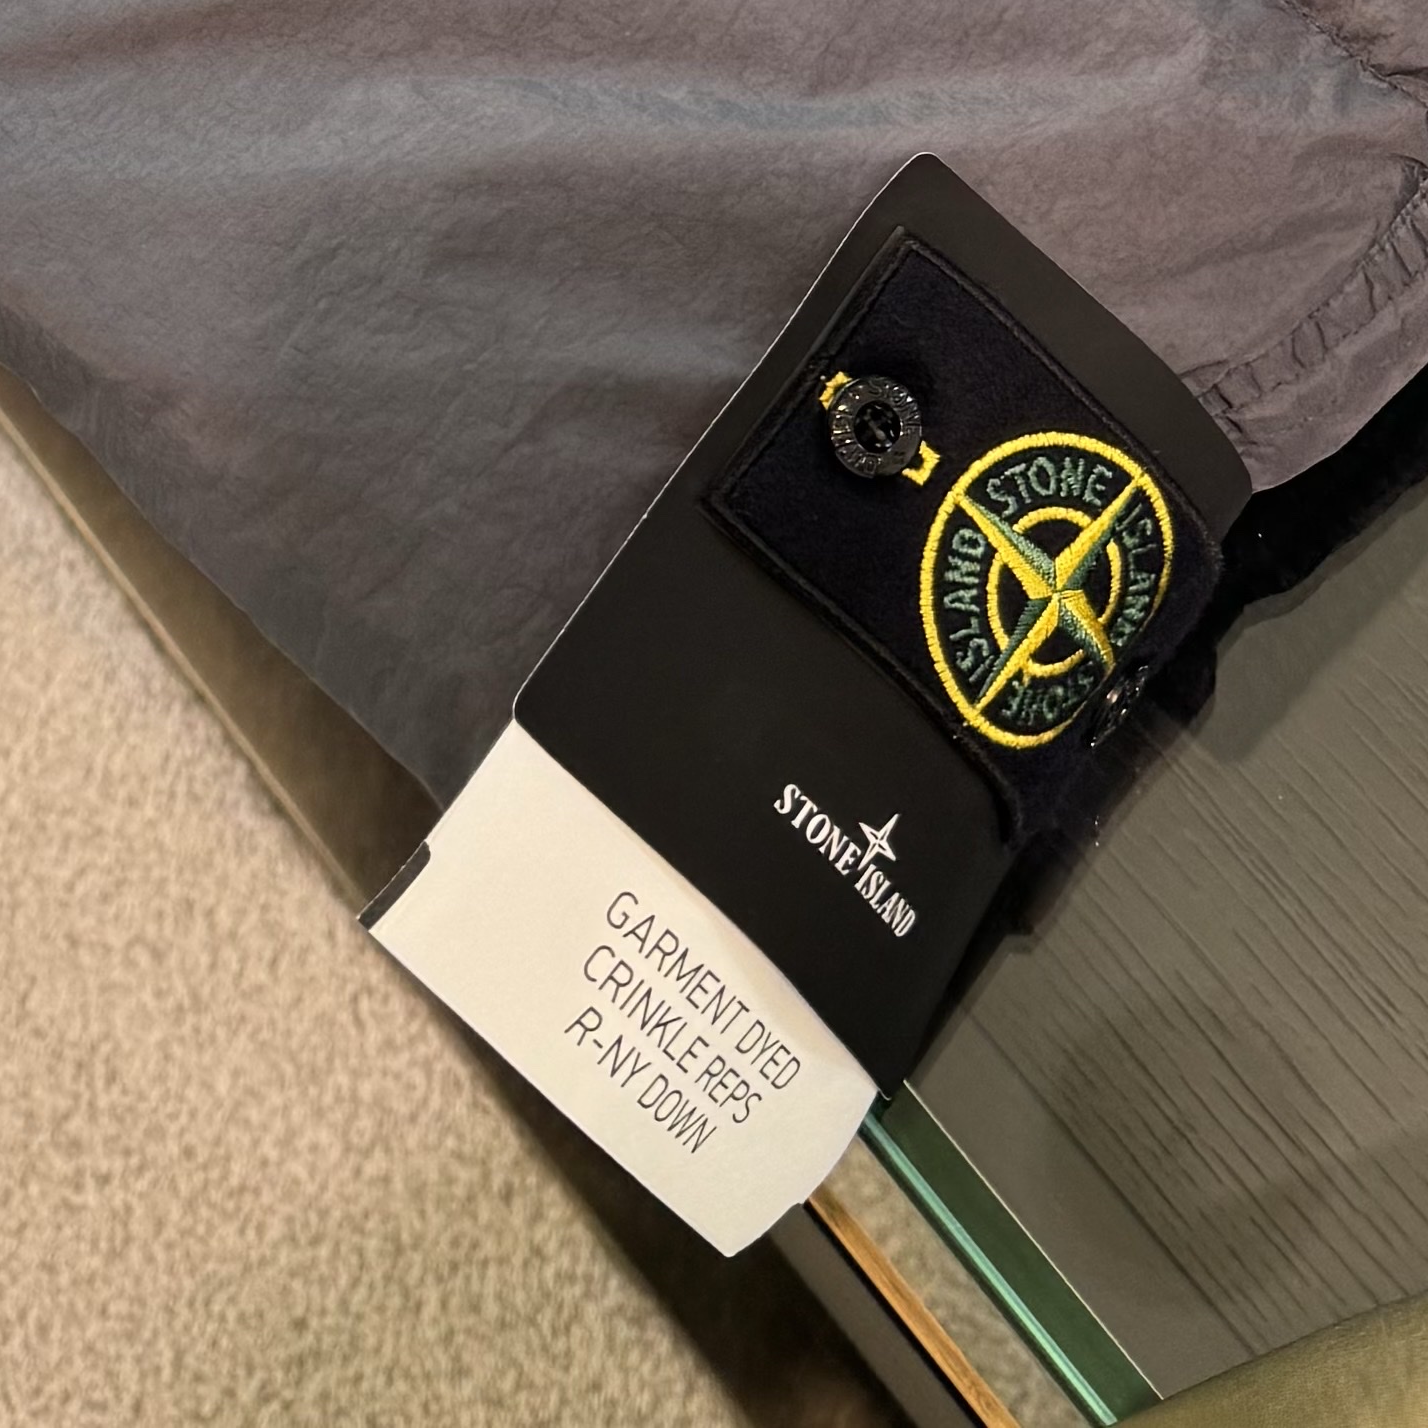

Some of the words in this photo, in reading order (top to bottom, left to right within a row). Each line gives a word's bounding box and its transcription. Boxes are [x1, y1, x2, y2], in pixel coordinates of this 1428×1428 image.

[986, 456, 1113, 517] STONE
[943, 528, 995, 682] ISLAND
[772, 783, 860, 875] STONE
[854, 861, 917, 938] ISLAND
[583, 944, 708, 1075] CRINKLE
[695, 1055, 763, 1124] REPS
[606, 891, 749, 1035] GARMENT
[735, 1017, 802, 1091] DYED
[565, 1007, 651, 1089] R-NY
[637, 1074, 717, 1155] DOWN
